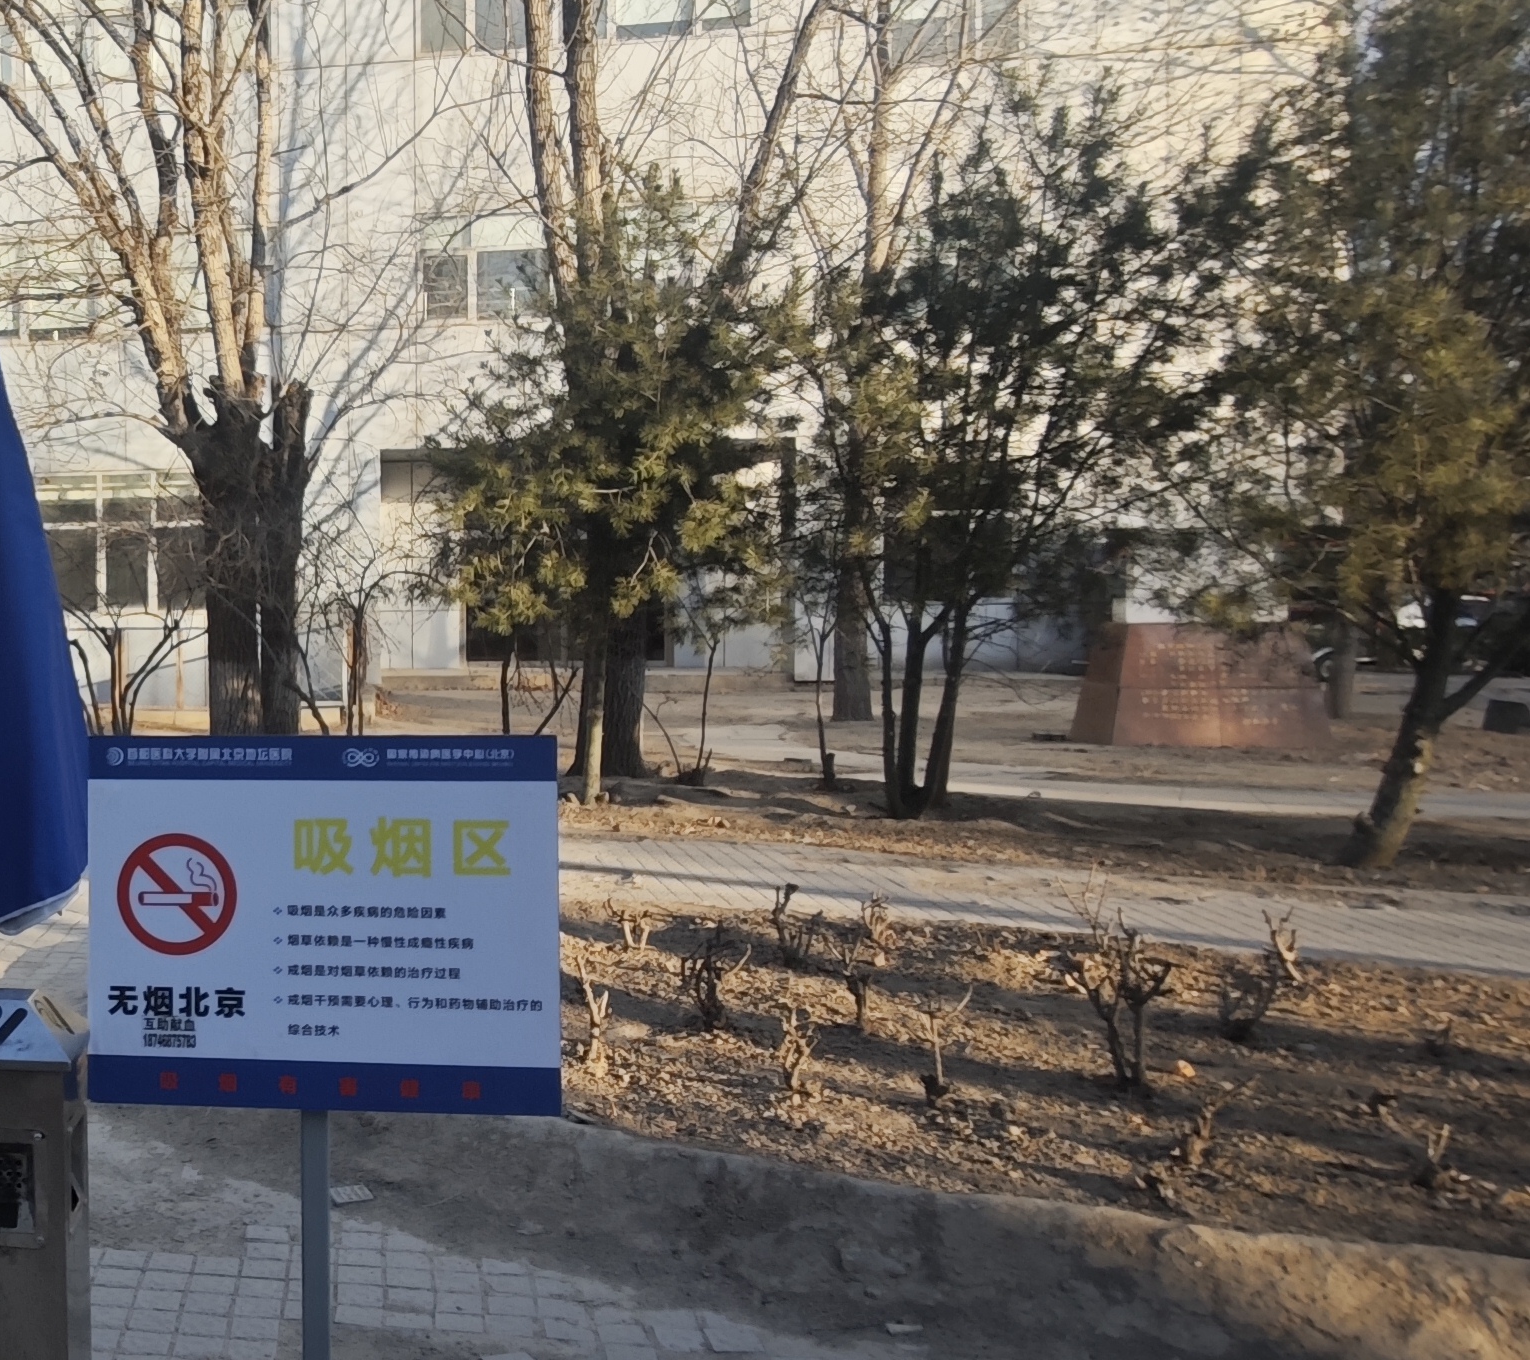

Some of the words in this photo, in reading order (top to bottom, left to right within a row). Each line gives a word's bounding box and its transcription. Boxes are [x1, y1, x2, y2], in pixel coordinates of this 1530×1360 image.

[293, 816, 511, 877] 吸烟区
[287, 905, 447, 920] 吸烟是众多疾病的危险因素
[287, 934, 475, 951] 烟草依赖是一种慢性成瘾性疾病
[287, 964, 461, 980] 戒烟是对烟草依赖的治疗过程
[107, 985, 246, 1018] 无烟北京
[287, 993, 543, 1012] 戒烟干预需要心理、行为和药物辅助治疗的
[143, 1017, 196, 1031] 互助献血
[287, 1023, 341, 1037] 综合技术
